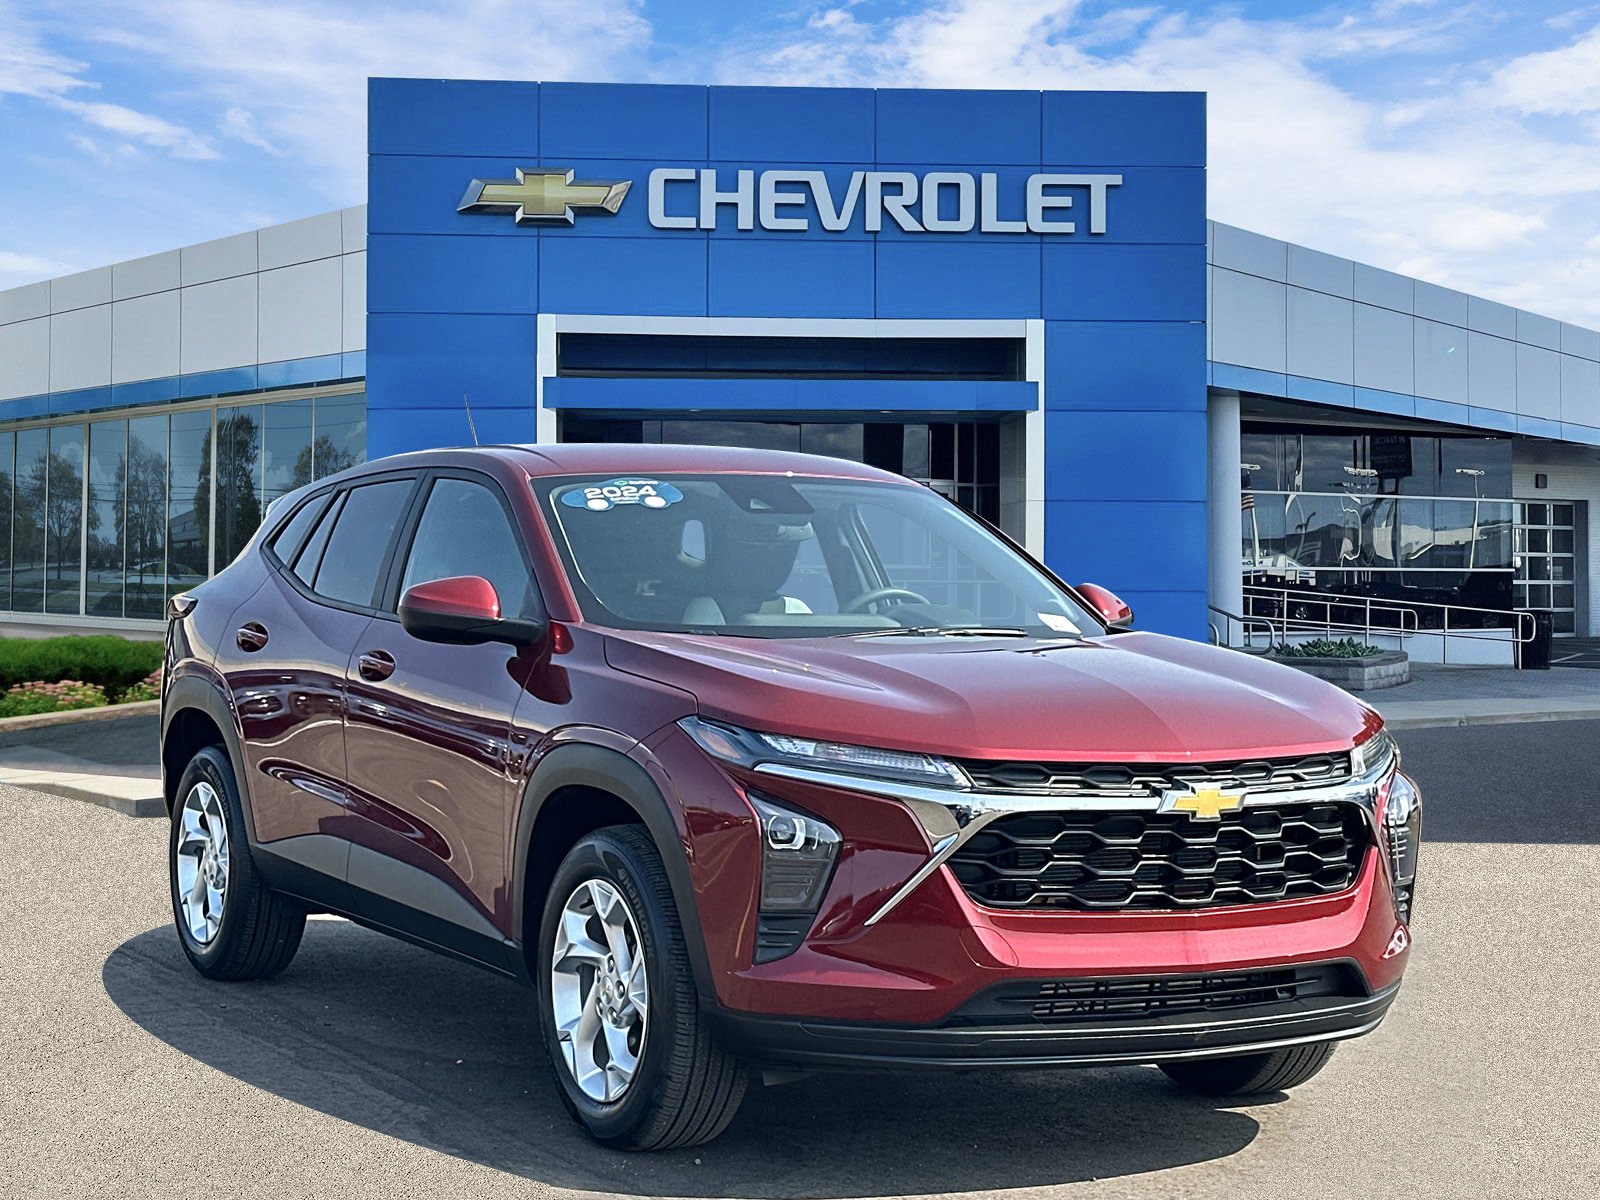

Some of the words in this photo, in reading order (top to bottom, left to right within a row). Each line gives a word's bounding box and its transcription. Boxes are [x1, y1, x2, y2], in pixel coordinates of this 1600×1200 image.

[648, 167, 1123, 234] CHEVROLET
[584, 485, 657, 499] 2024
[623, 877, 655, 959] Hankook
